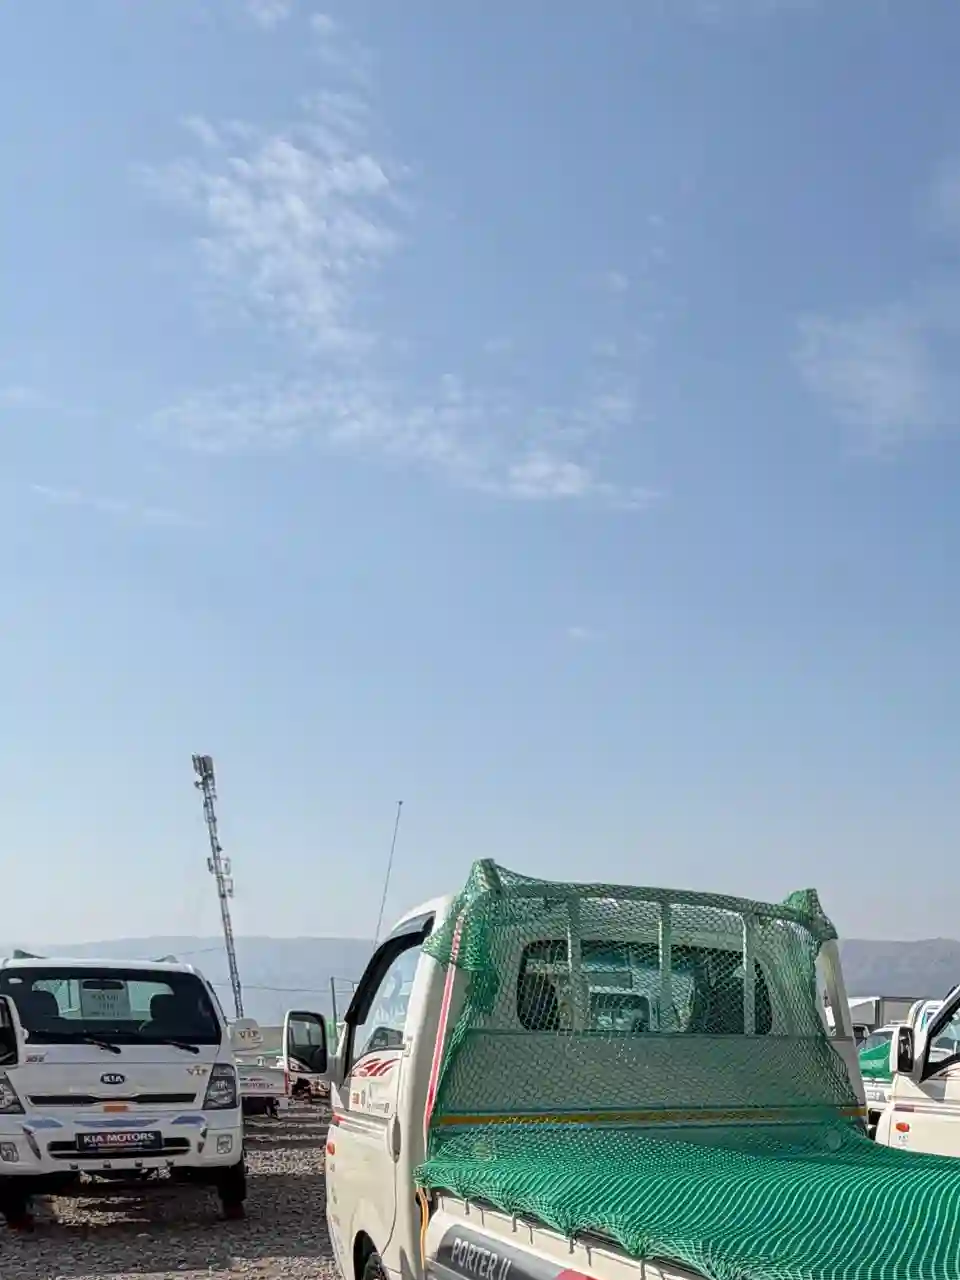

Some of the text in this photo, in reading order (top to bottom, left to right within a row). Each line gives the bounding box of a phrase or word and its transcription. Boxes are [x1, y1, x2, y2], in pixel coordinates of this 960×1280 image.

[103, 1074, 125, 1083] KIA
[83, 1132, 155, 1145] KIA MOTORS
[450, 1237, 498, 1280] PORTER
